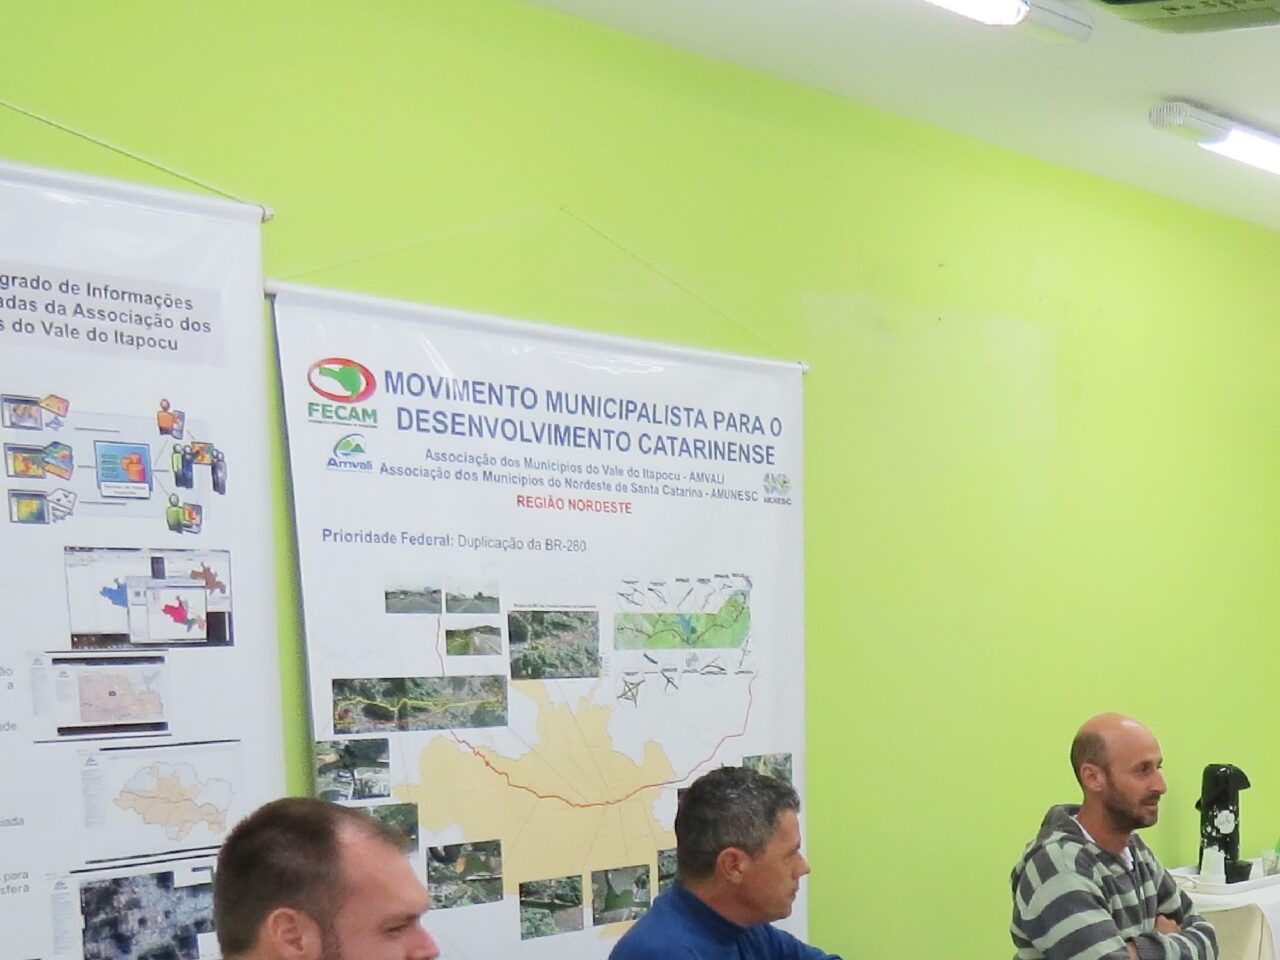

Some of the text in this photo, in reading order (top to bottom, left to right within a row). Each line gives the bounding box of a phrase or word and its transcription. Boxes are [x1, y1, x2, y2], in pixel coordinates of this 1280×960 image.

[59, 279, 80, 295] de
[87, 282, 193, 311] Informações
[45, 300, 66, 316] da
[73, 303, 173, 330] Associação
[180, 315, 211, 333] dos
[12, 318, 35, 334] do
[41, 320, 80, 339] Vale
[87, 327, 108, 343] do
[114, 330, 178, 350] Itapocu
[308, 402, 378, 424] FECAM
[384, 370, 782, 437] MOVIMENTO MUNICIPALISTA PARA O
[397, 407, 775, 466] DESENVOLVIMENTO CATARINENSE
[327, 457, 373, 470] Amvali
[425, 448, 497, 467] Associação
[500, 452, 520, 467] dos
[586, 459, 600, 475] do
[602, 461, 624, 477] Vale
[627, 465, 641, 480] do
[642, 466, 681, 484] Itapocu
[689, 471, 725, 485] AMVALI
[380, 463, 451, 481] Associação
[455, 466, 478, 482] dos
[548, 476, 562, 489] do
[564, 478, 612, 493] Nordeste
[615, 482, 628, 494] de
[630, 483, 660, 497] Santa
[662, 485, 704, 499] Catarina
[710, 487, 759, 502] AMUNESC
[517, 494, 633, 515] REGIÃO NORDESTE
[322, 528, 587, 553] Prioridade Federal: Duplicação da BR-280
